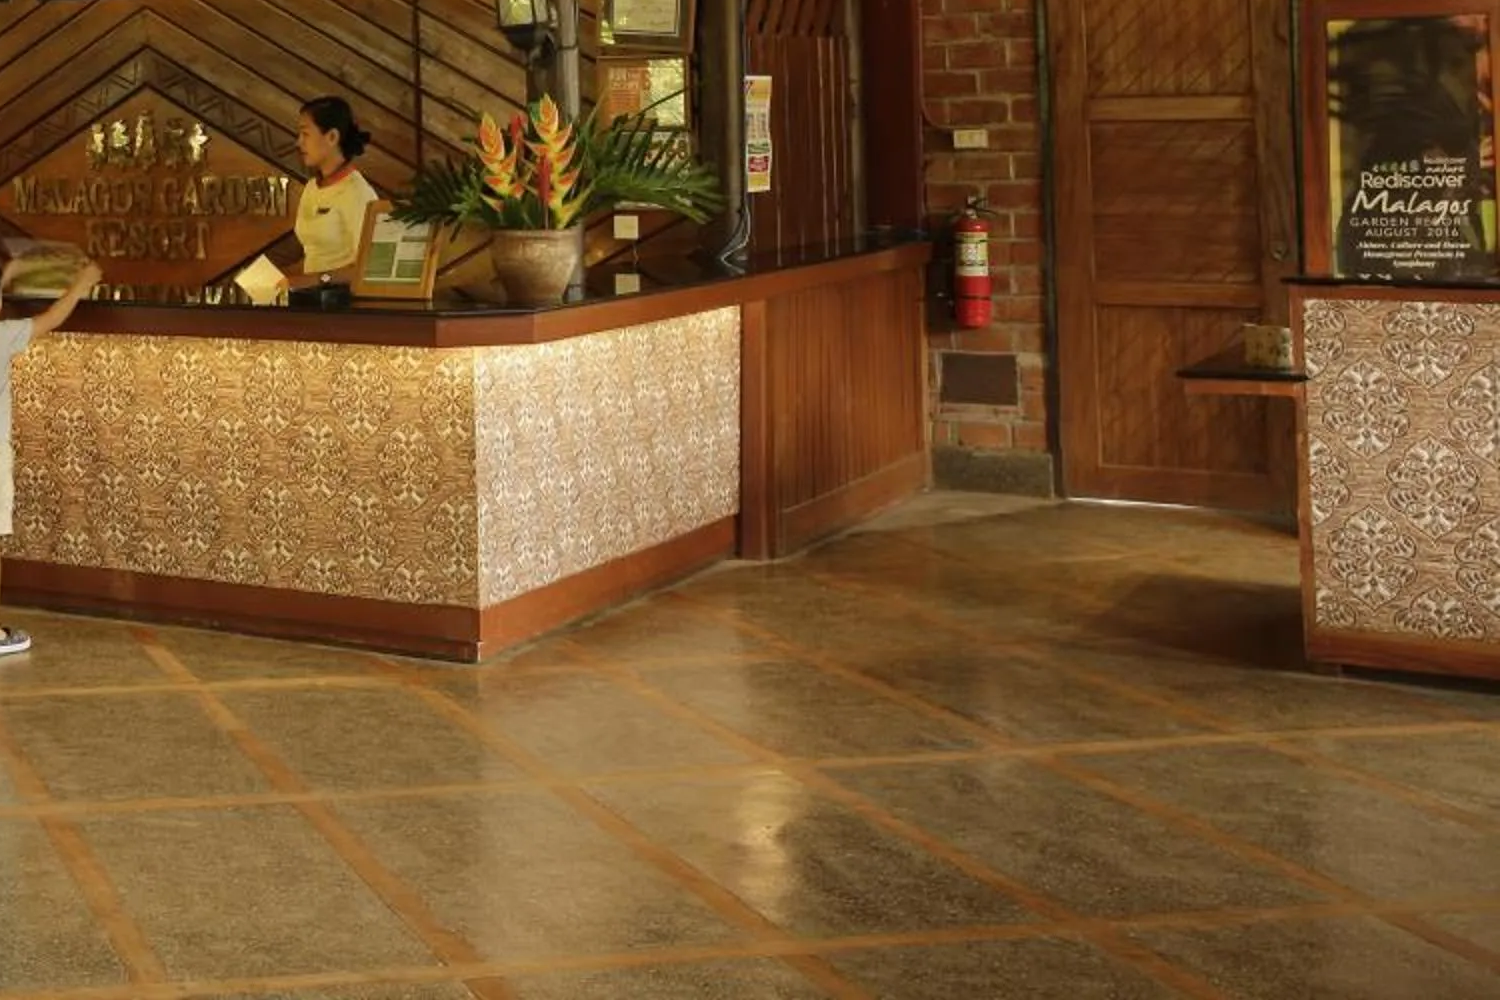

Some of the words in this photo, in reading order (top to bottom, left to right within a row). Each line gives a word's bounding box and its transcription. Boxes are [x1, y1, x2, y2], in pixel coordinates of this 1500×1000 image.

[1361, 171, 1467, 189] Rediscover
[160, 175, 289, 217] GARDEN
[1351, 189, 1472, 225] Malagos
[1349, 216, 1409, 227] GARDEN
[1365, 227, 1418, 237] AUGUST
[1427, 227, 1459, 237] 2016
[86, 218, 210, 260] RESORT
